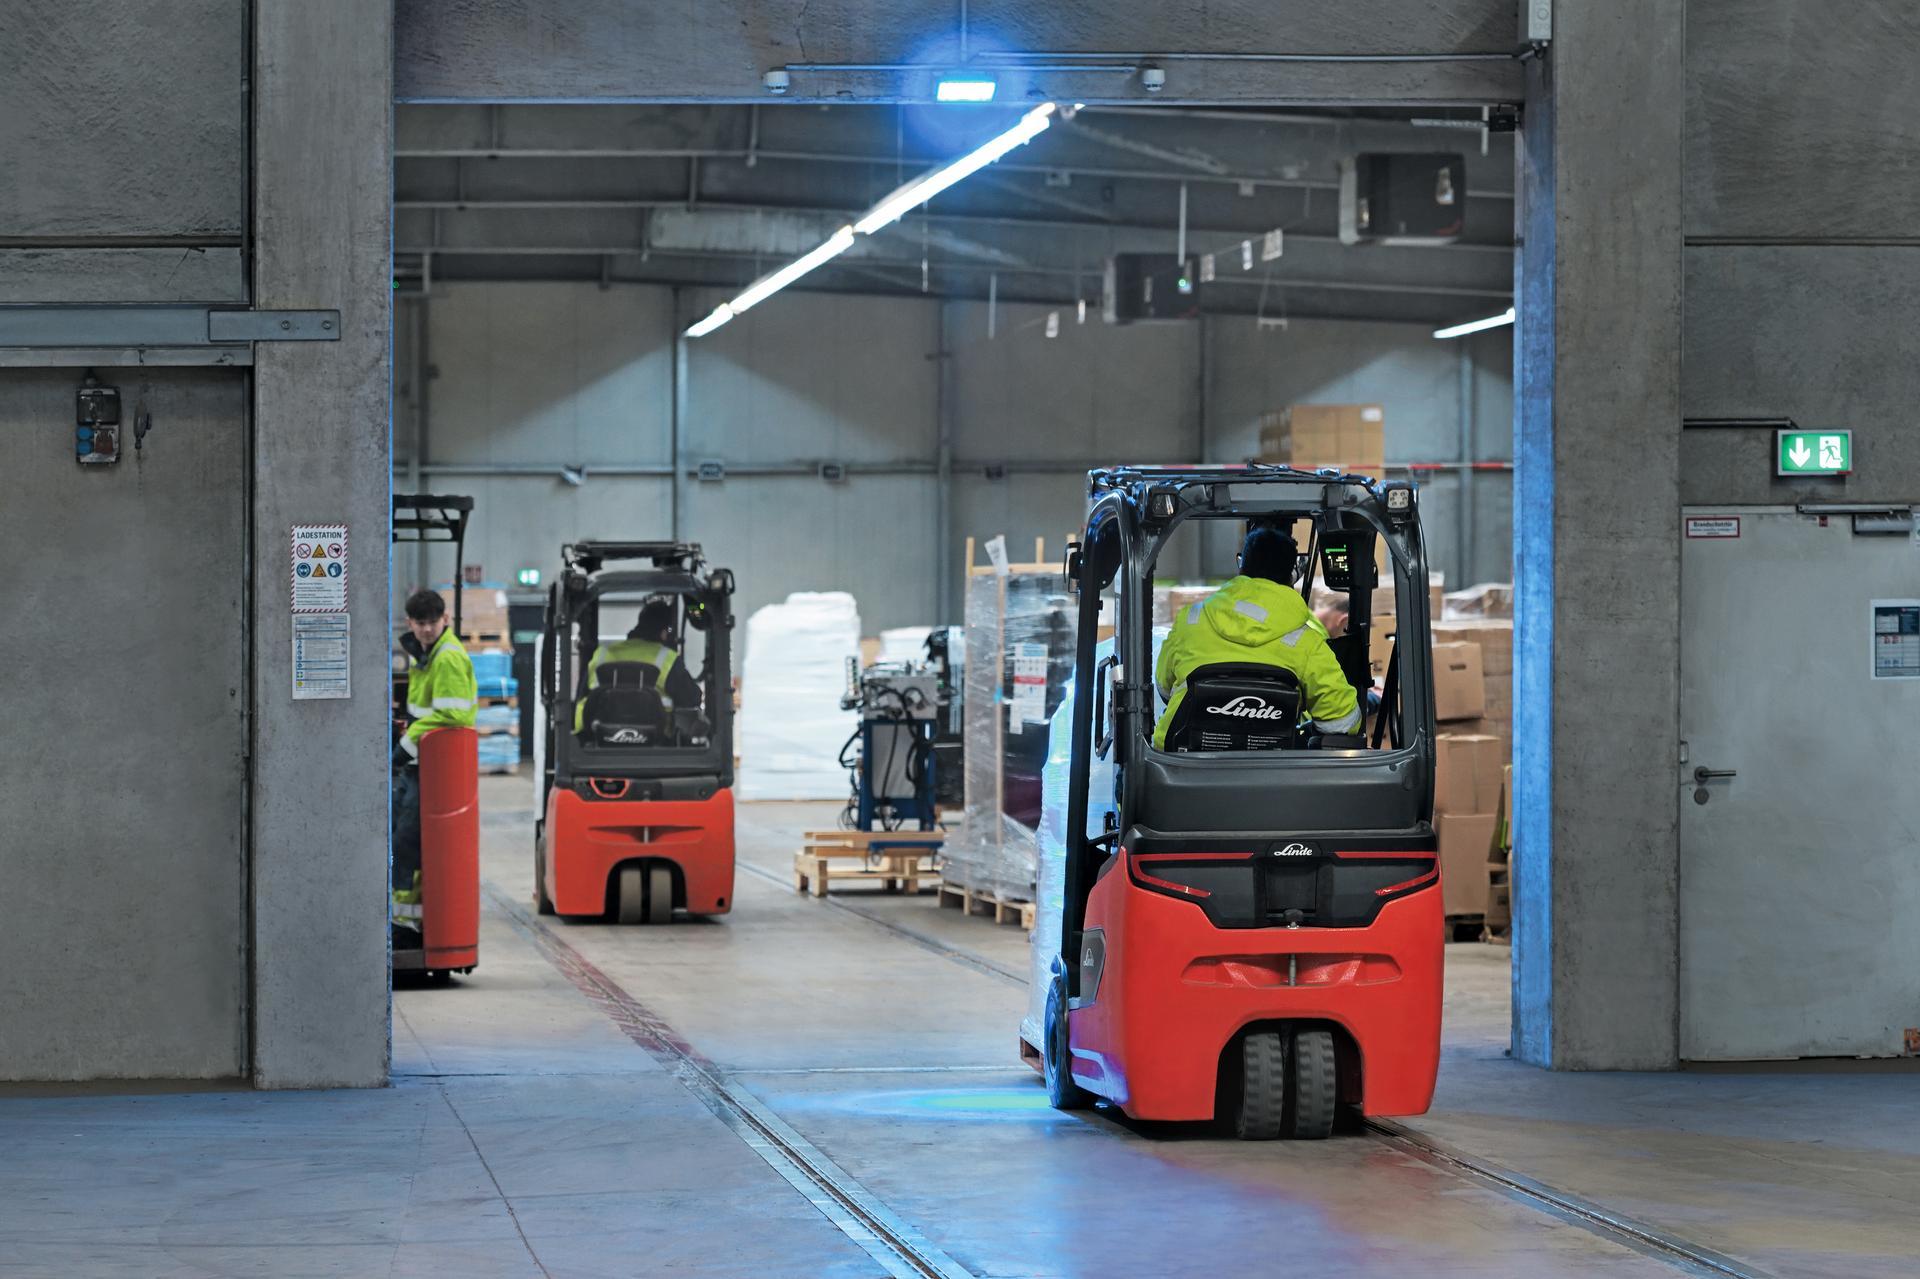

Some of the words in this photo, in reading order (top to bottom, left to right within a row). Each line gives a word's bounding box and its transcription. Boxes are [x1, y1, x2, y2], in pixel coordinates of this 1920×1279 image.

[297, 531, 342, 539] LADESTATION
[1206, 696, 1282, 720] Linde
[1273, 843, 1313, 857] Linde
